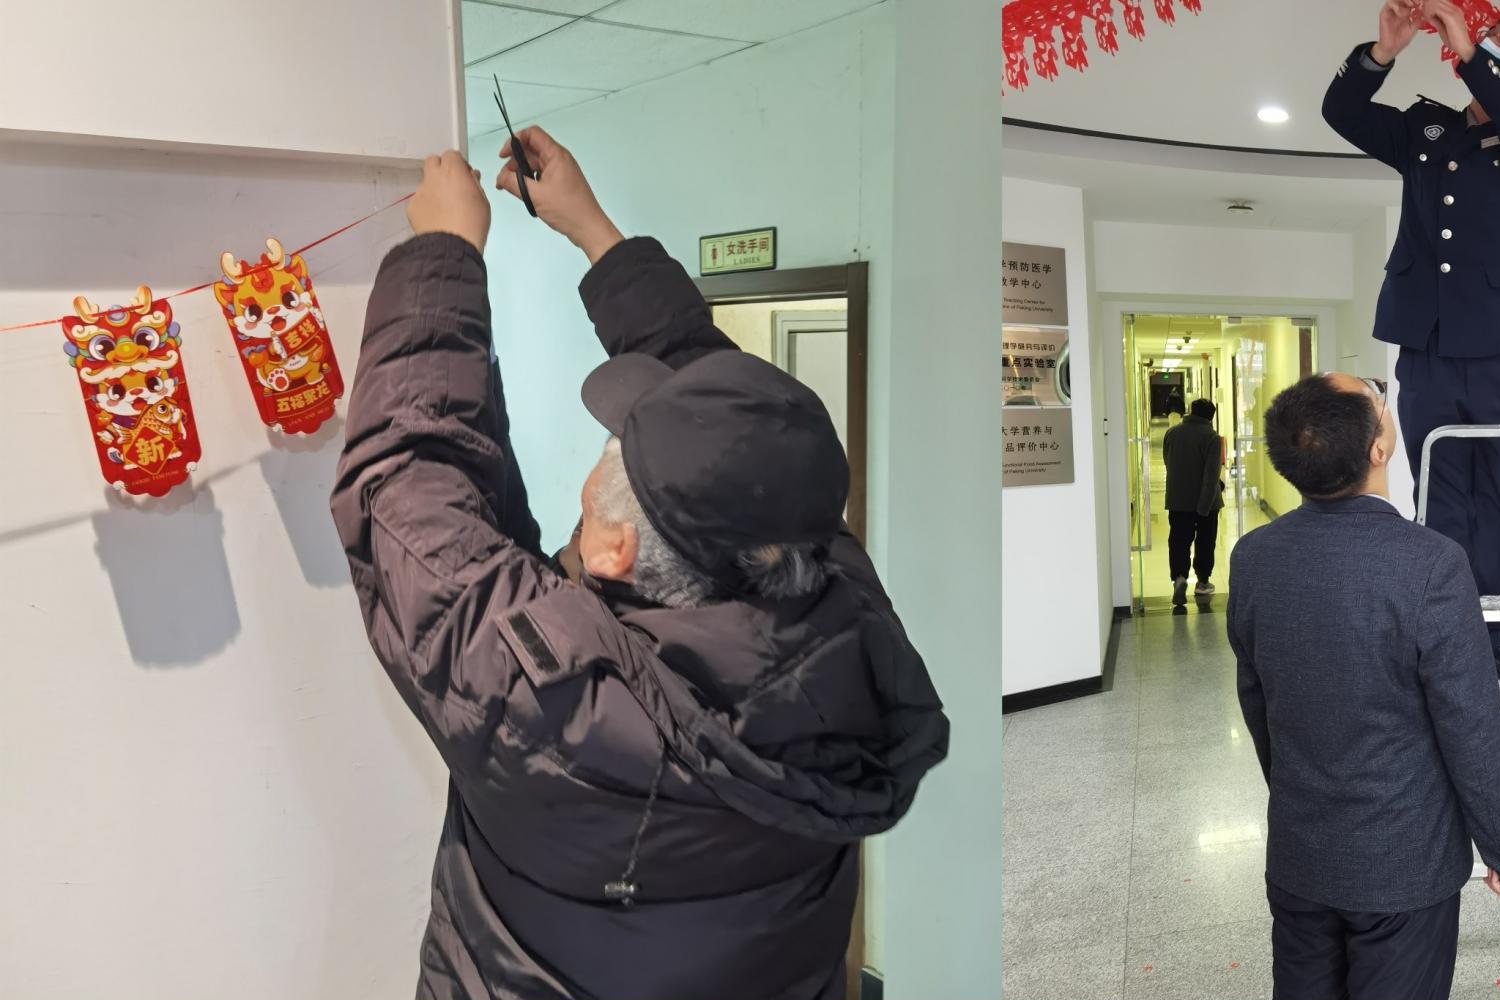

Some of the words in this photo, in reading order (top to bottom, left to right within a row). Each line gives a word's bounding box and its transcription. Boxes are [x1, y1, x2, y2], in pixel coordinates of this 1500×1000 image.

[726, 237, 769, 256] 女洗手间
[285, 319, 316, 348] 吉祥
[135, 435, 165, 466] 新
[1005, 441, 1060, 452] 品评价中心
